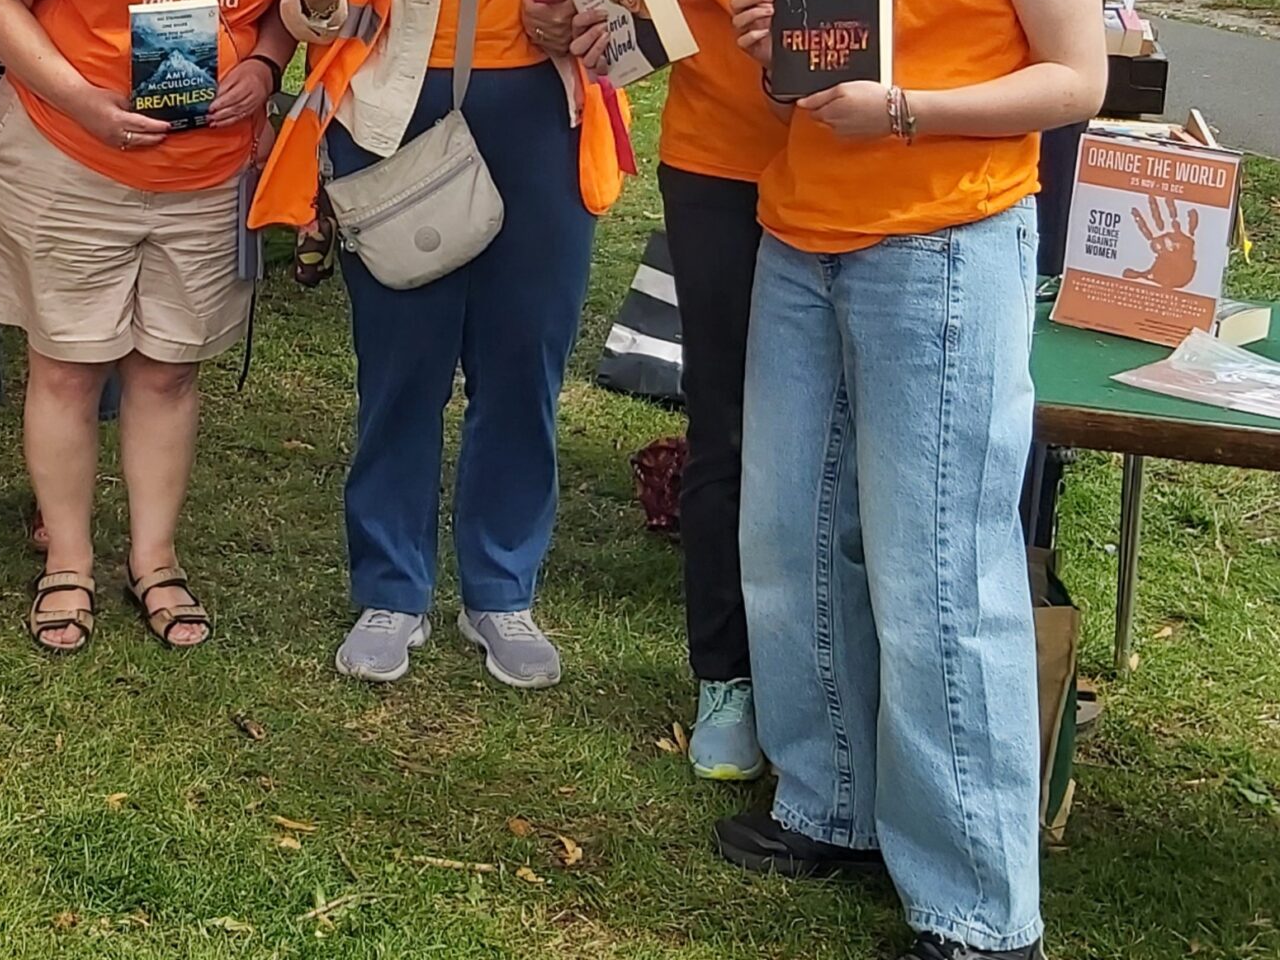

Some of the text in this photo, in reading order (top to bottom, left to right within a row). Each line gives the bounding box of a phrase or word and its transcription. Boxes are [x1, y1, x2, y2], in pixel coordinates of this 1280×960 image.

[606, 13, 628, 33] oria
[782, 28, 869, 51] FRIENDLY
[809, 49, 850, 71] FIRE
[147, 77, 204, 90] McCULLOCH
[165, 71, 187, 80] AMY
[135, 87, 216, 111] BREATHLESS
[1088, 146, 1227, 188] ORANGE THE WORLD
[1089, 208, 1121, 229] STOP
[1086, 234, 1118, 249] AGAINST
[1087, 225, 1119, 239] VIOLENCE
[1085, 244, 1117, 259] WOMEN
